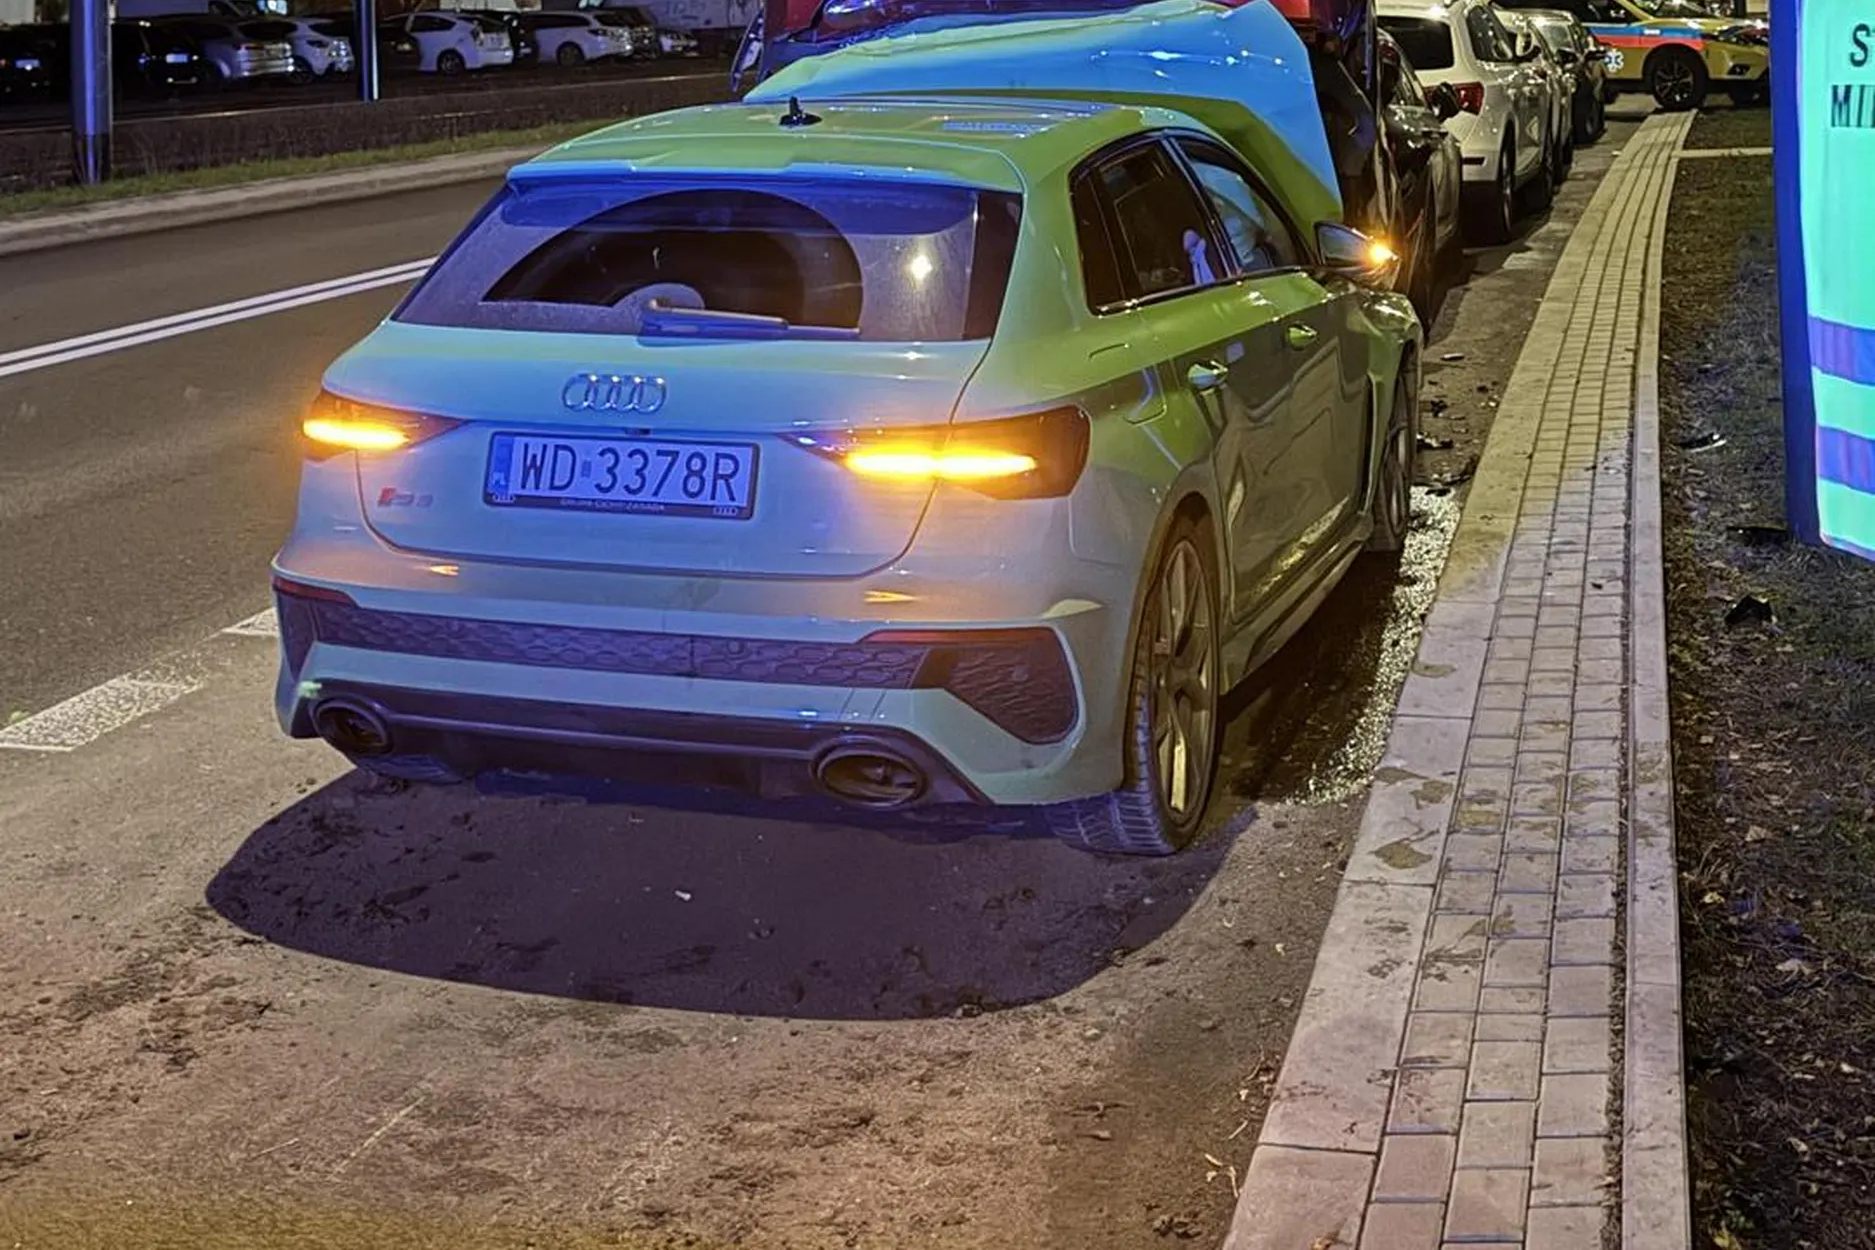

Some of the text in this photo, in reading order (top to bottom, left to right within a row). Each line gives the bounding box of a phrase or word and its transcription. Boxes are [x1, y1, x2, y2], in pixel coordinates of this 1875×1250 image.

[1850, 23, 1875, 67] S
[1831, 85, 1875, 128] MI
[520, 442, 741, 502] WD 3378R
